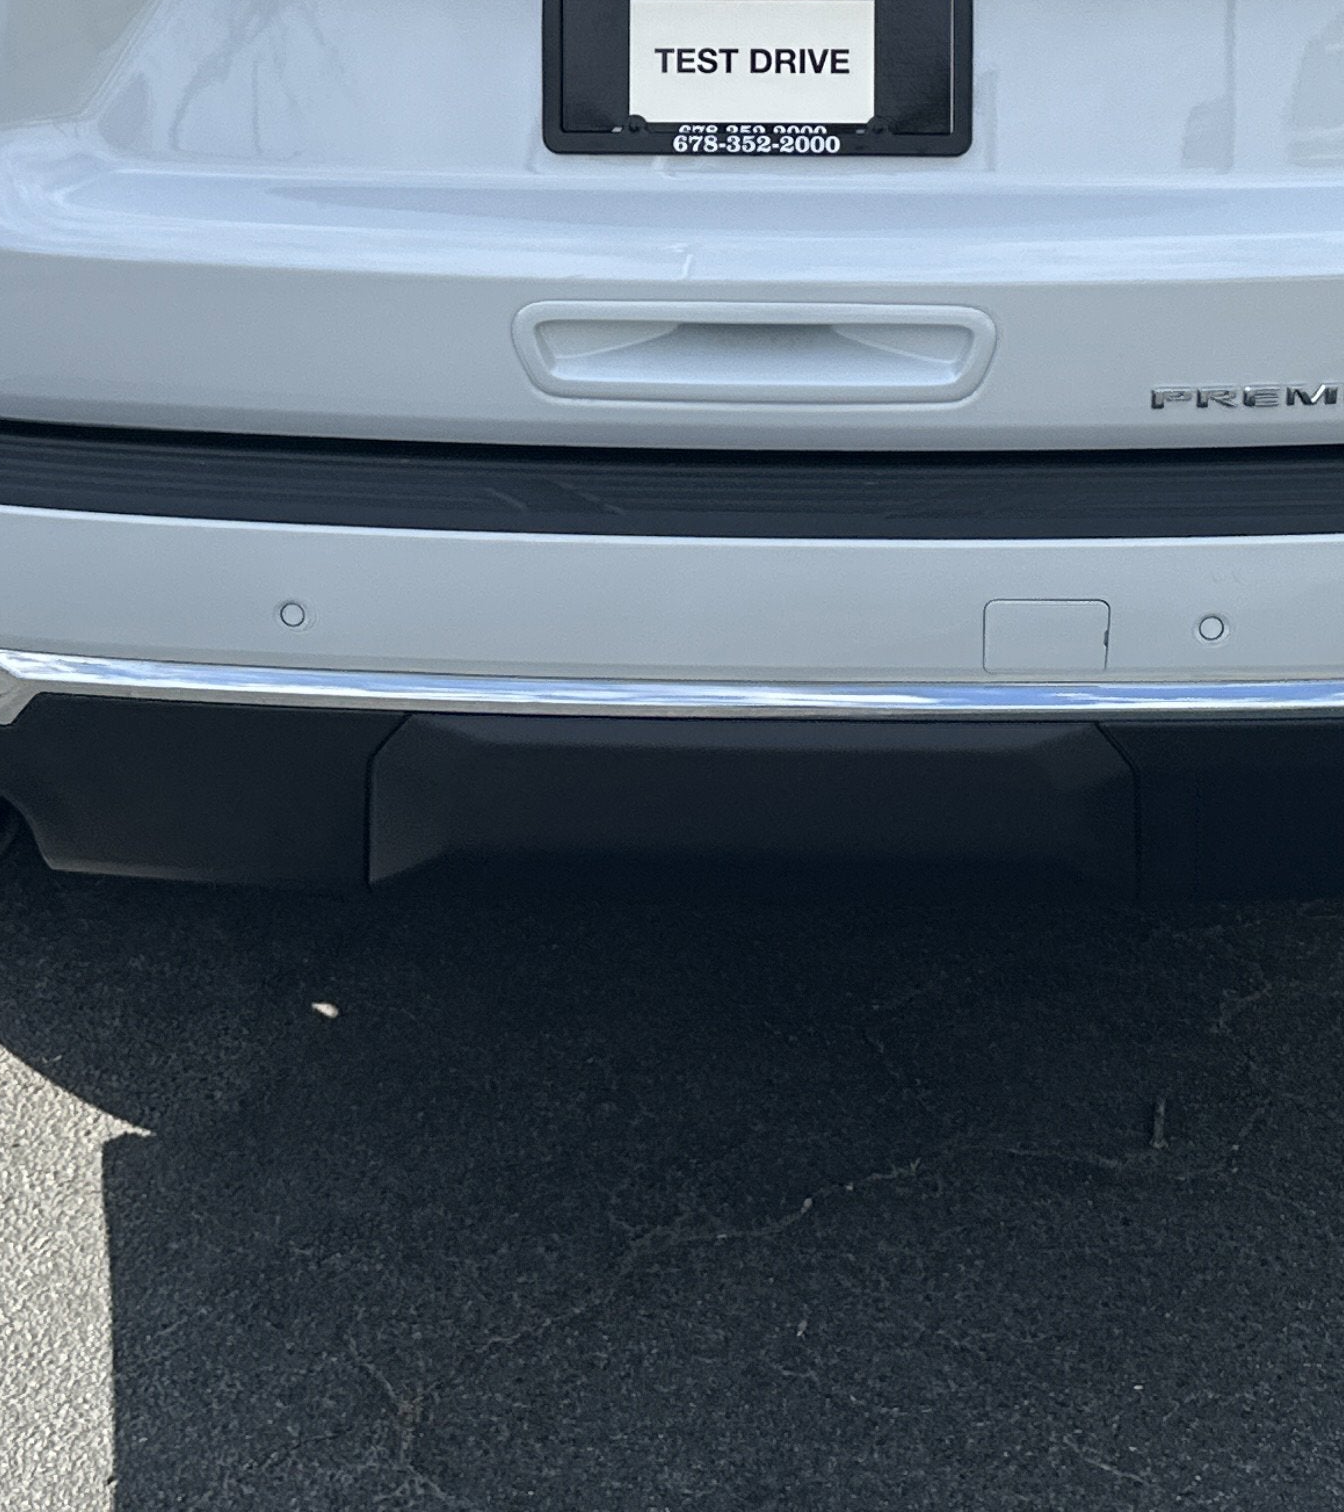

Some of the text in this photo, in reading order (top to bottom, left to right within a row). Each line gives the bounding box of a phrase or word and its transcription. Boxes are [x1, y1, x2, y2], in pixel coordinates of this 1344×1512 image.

[654, 48, 850, 74] TEST DRIVE
[672, 135, 841, 153] 678-352-2000
